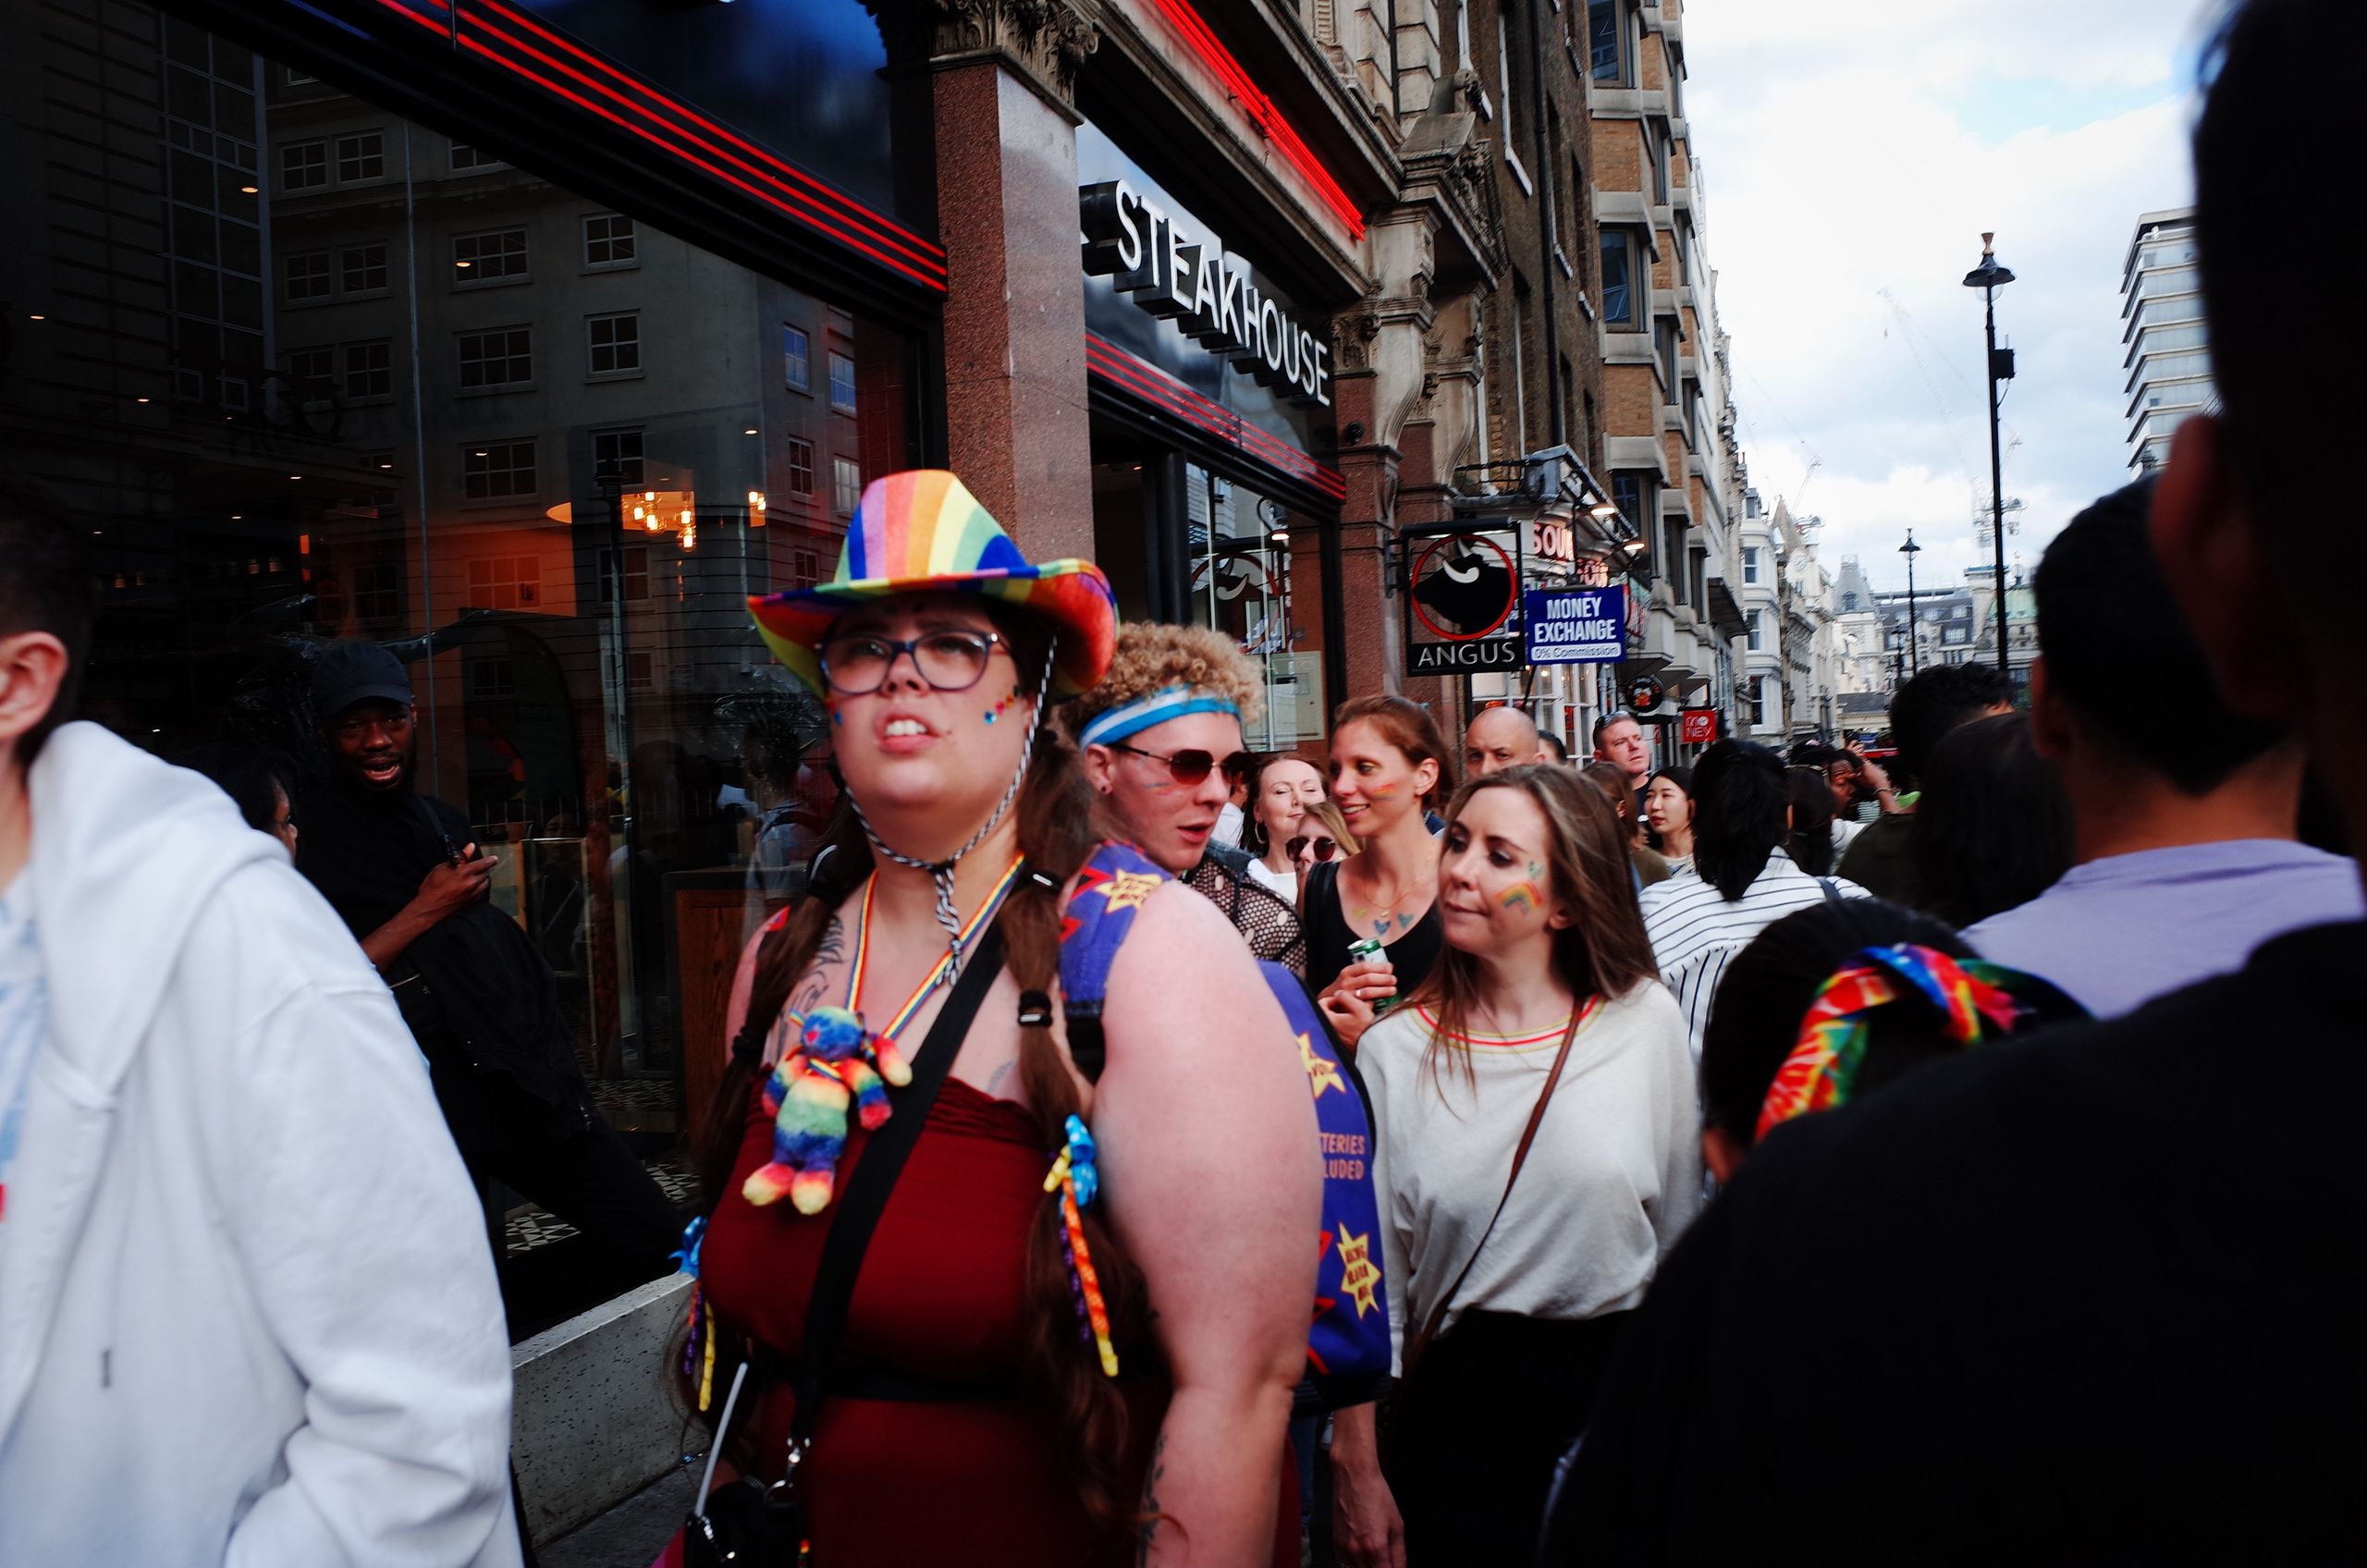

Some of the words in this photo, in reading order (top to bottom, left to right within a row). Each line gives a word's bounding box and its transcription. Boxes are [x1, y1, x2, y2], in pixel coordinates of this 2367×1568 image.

[1115, 178, 1331, 408] STEAKHOUSE
[1546, 596, 1602, 619] MONEY
[1534, 619, 1617, 643] EXCHANGE
[1417, 641, 1515, 668] ANGUS
[1535, 647, 1551, 659] 0%
[1553, 645, 1618, 658] Commission
